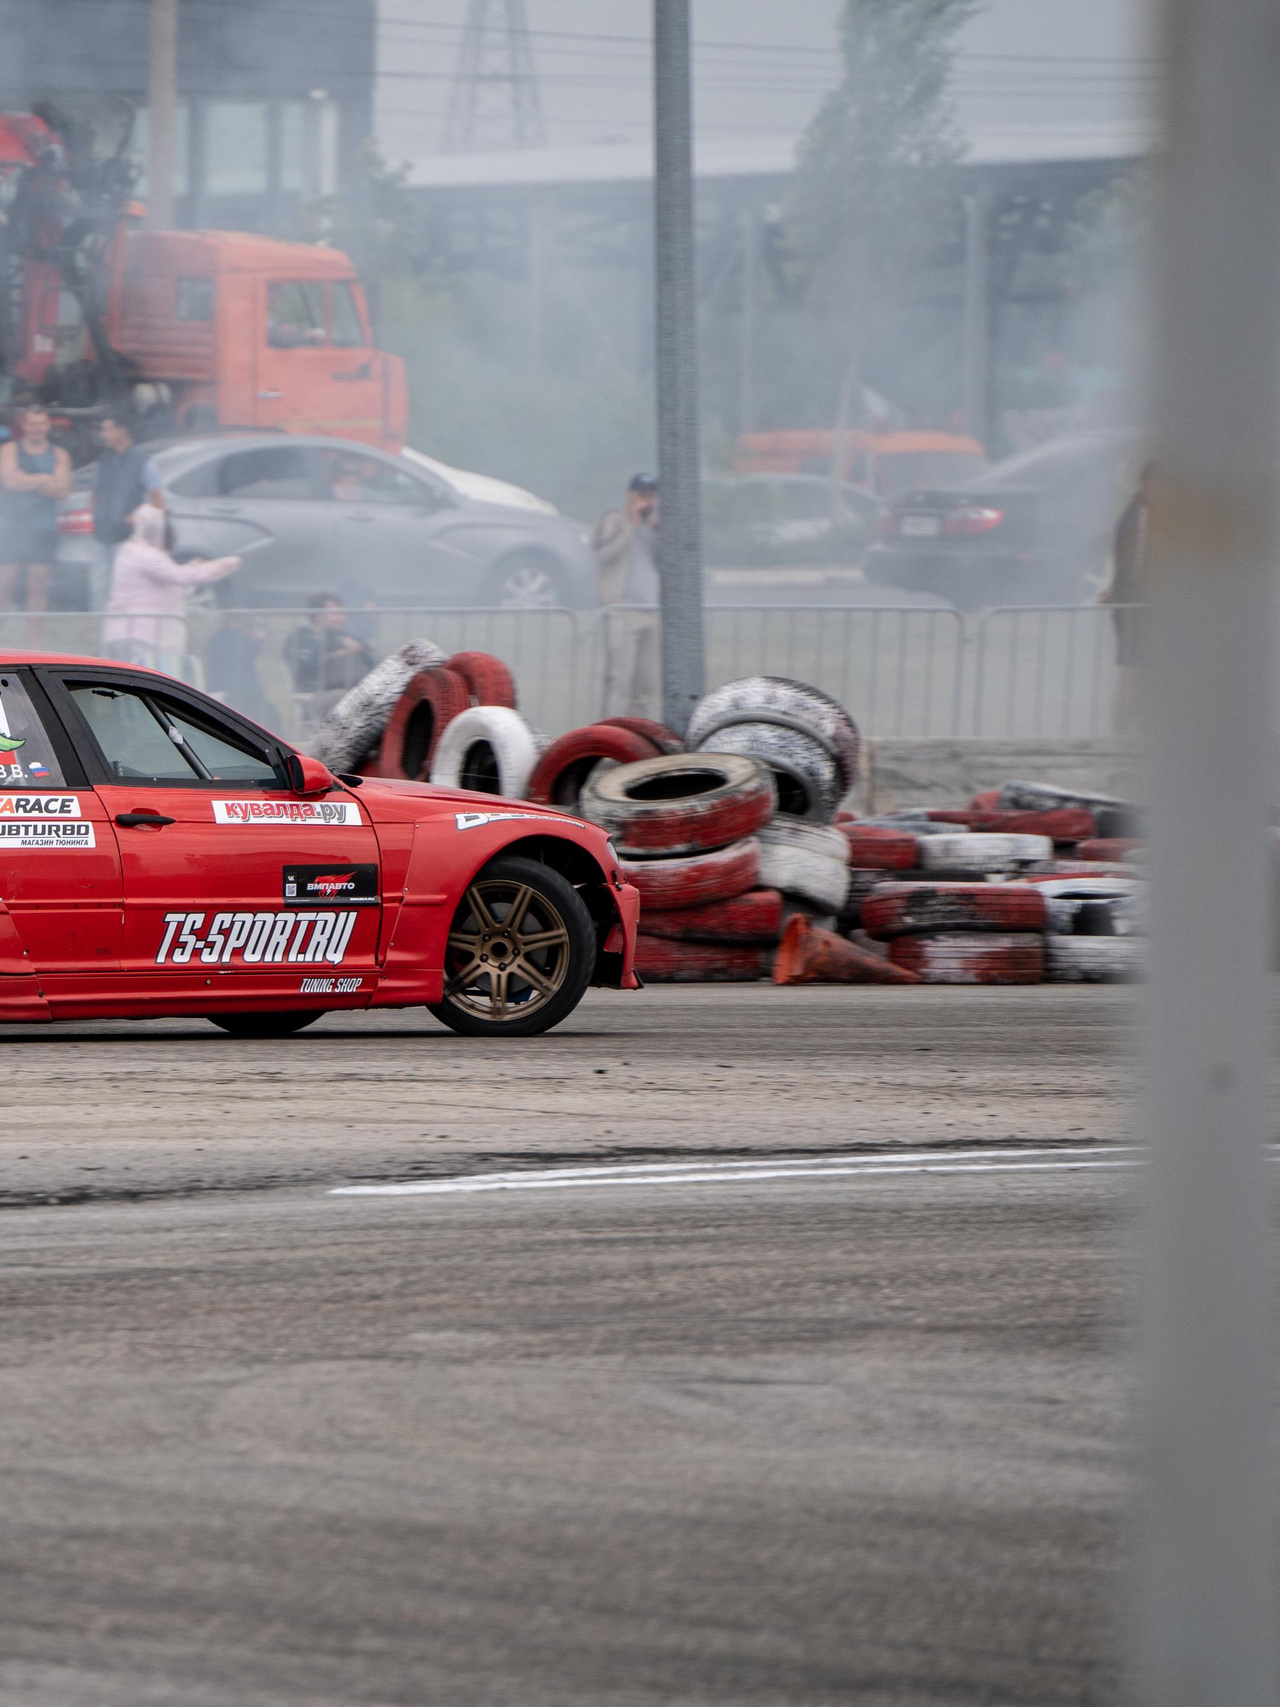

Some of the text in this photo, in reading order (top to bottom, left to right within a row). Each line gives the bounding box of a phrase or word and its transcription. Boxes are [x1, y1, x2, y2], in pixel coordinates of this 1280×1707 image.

[10, 763, 29, 779] В.
[224, 802, 347, 823] кувалда.ру
[20, 839, 89, 847] МАГАЗИН ТЮНИНГА
[306, 882, 356, 891] ВМПАВТО
[154, 910, 359, 967] TS-SPORT.RU
[299, 977, 363, 993] TUNING SHOP
